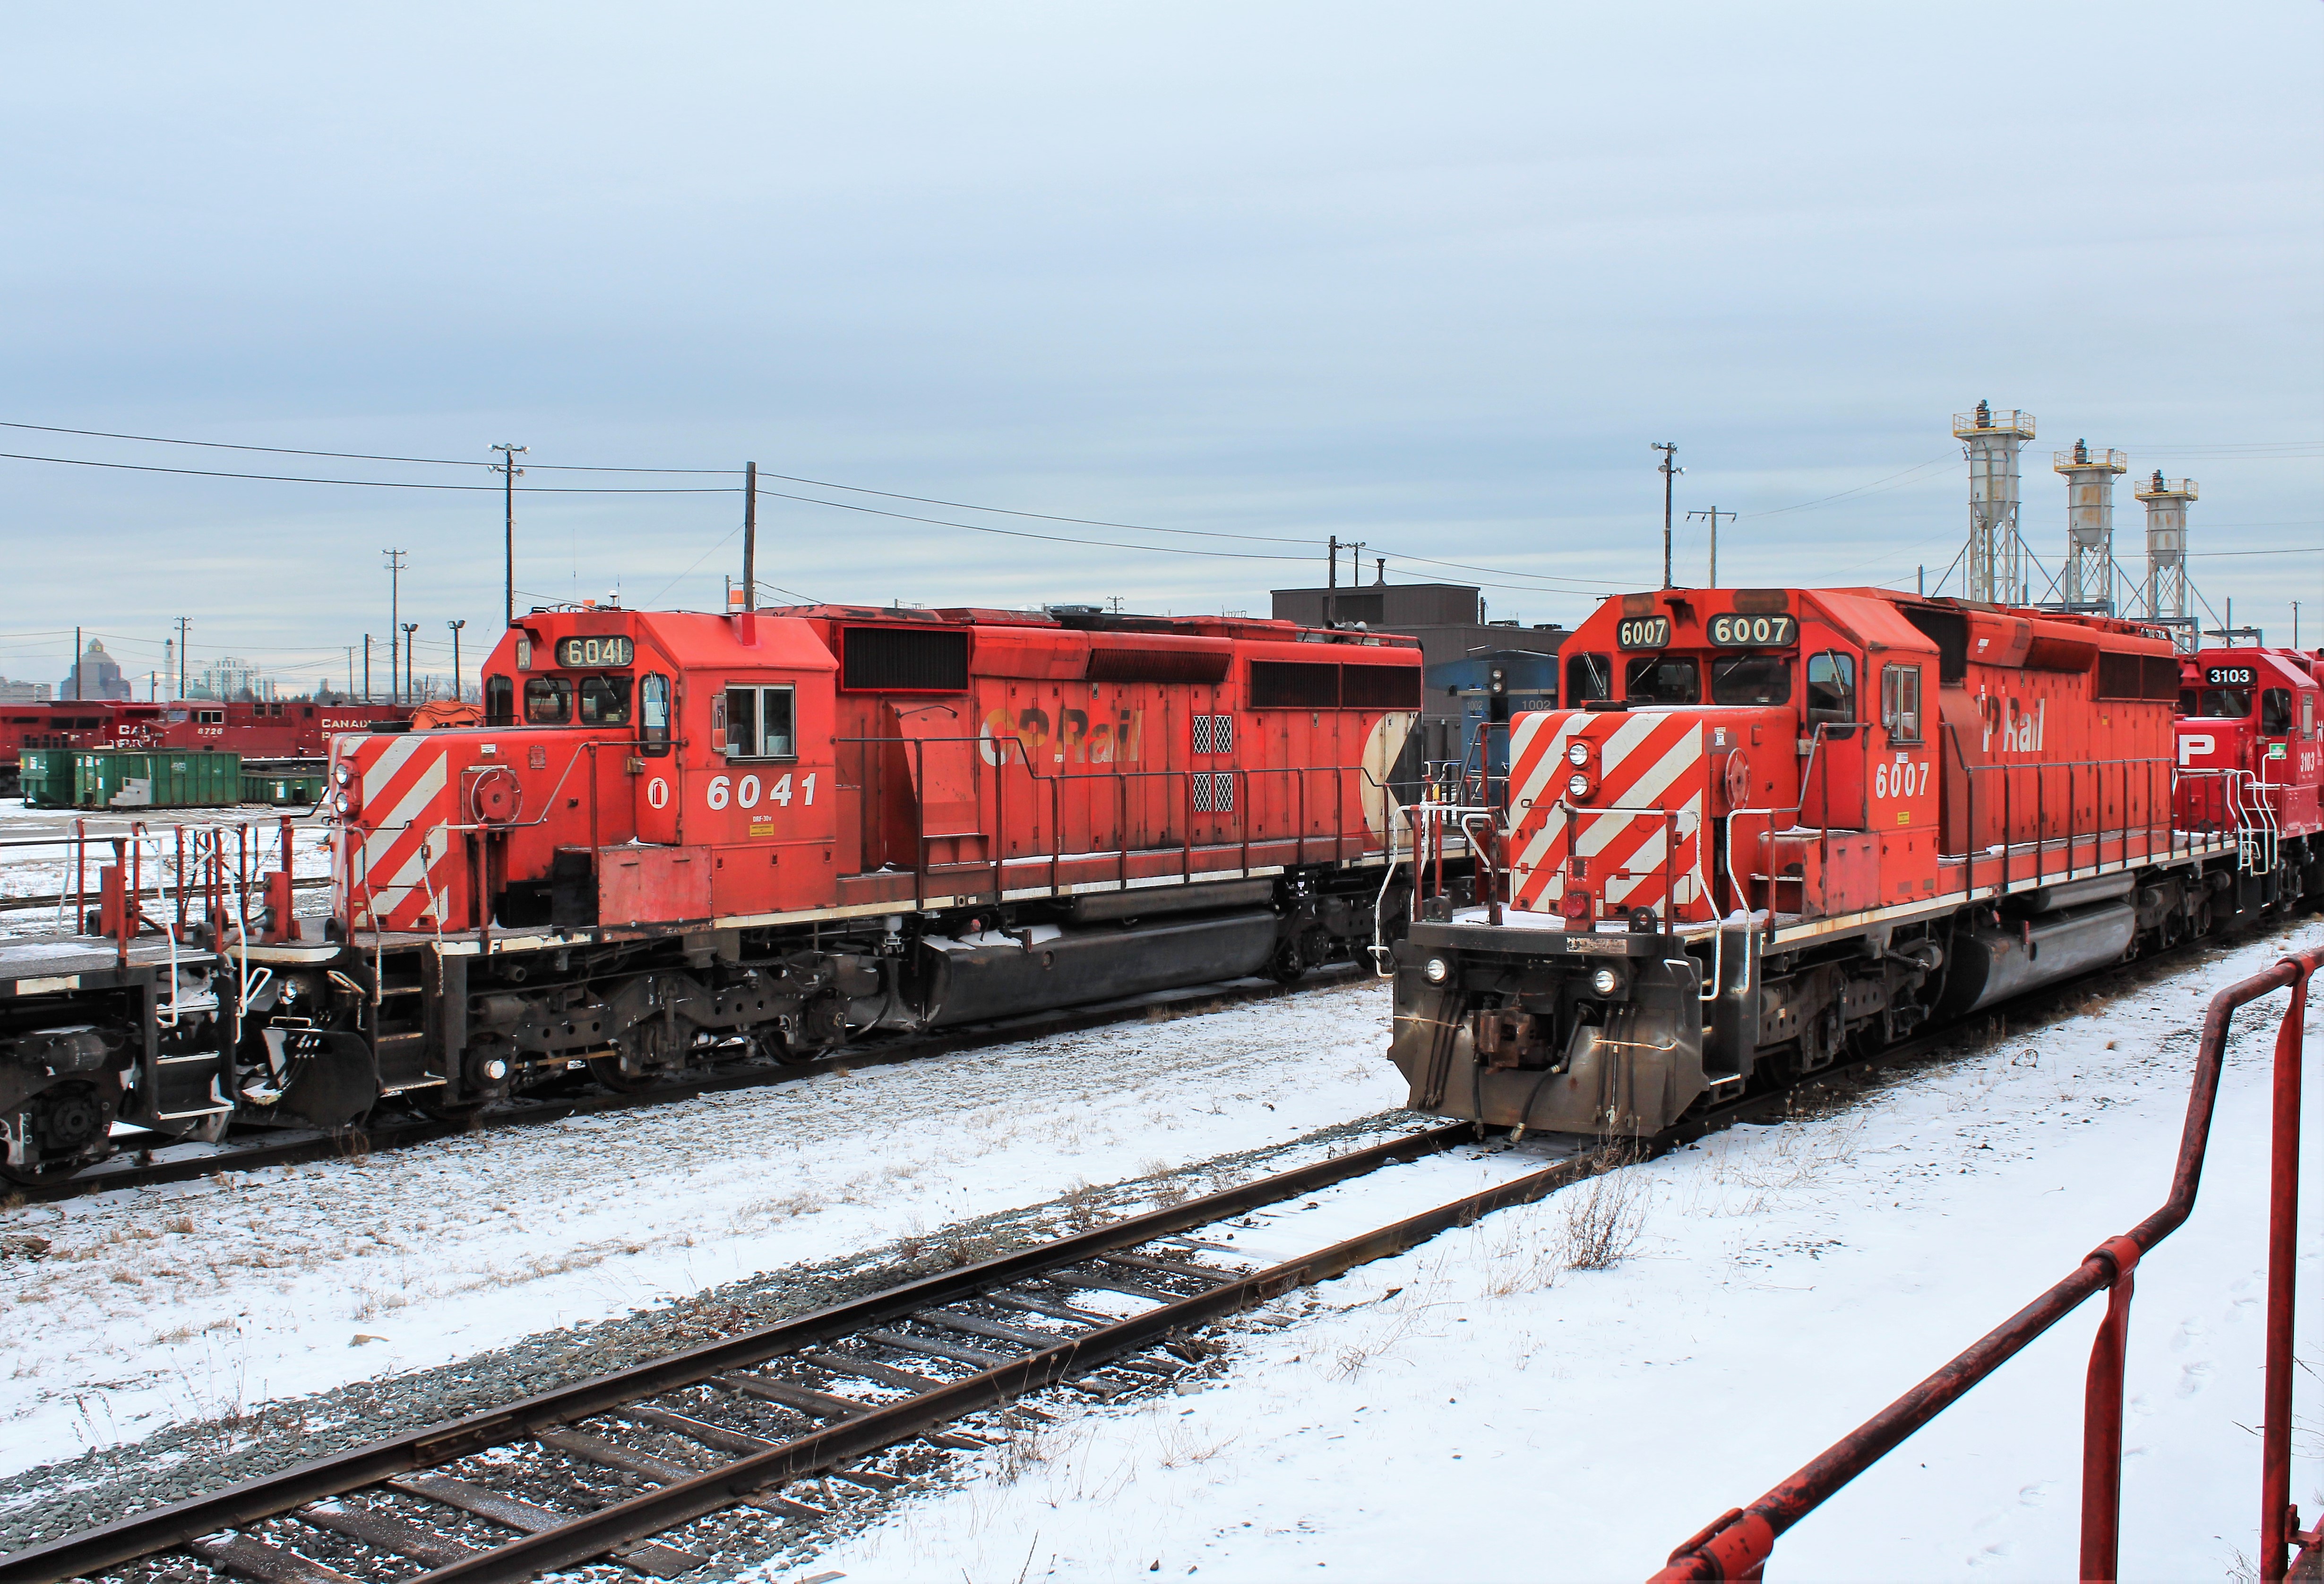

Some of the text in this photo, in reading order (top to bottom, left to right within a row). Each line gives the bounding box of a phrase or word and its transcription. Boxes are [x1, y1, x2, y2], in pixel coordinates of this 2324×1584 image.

[1622, 619, 1666, 645] 6007
[1714, 617, 1789, 642] 6007
[568, 638, 623, 664] 6041
[2211, 669, 2250, 683] 3103
[1467, 701, 1483, 711] 1002
[1522, 700, 1551, 710] 1002
[321, 719, 371, 728] CANAD
[2003, 696, 2046, 753] Rail
[979, 708, 1143, 767] CP Rail
[2178, 734, 2215, 765] P
[2300, 751, 2315, 772] 3103
[706, 772, 816, 811] 6041
[1876, 762, 1929, 799] 6007
[488, 939, 502, 955] F
